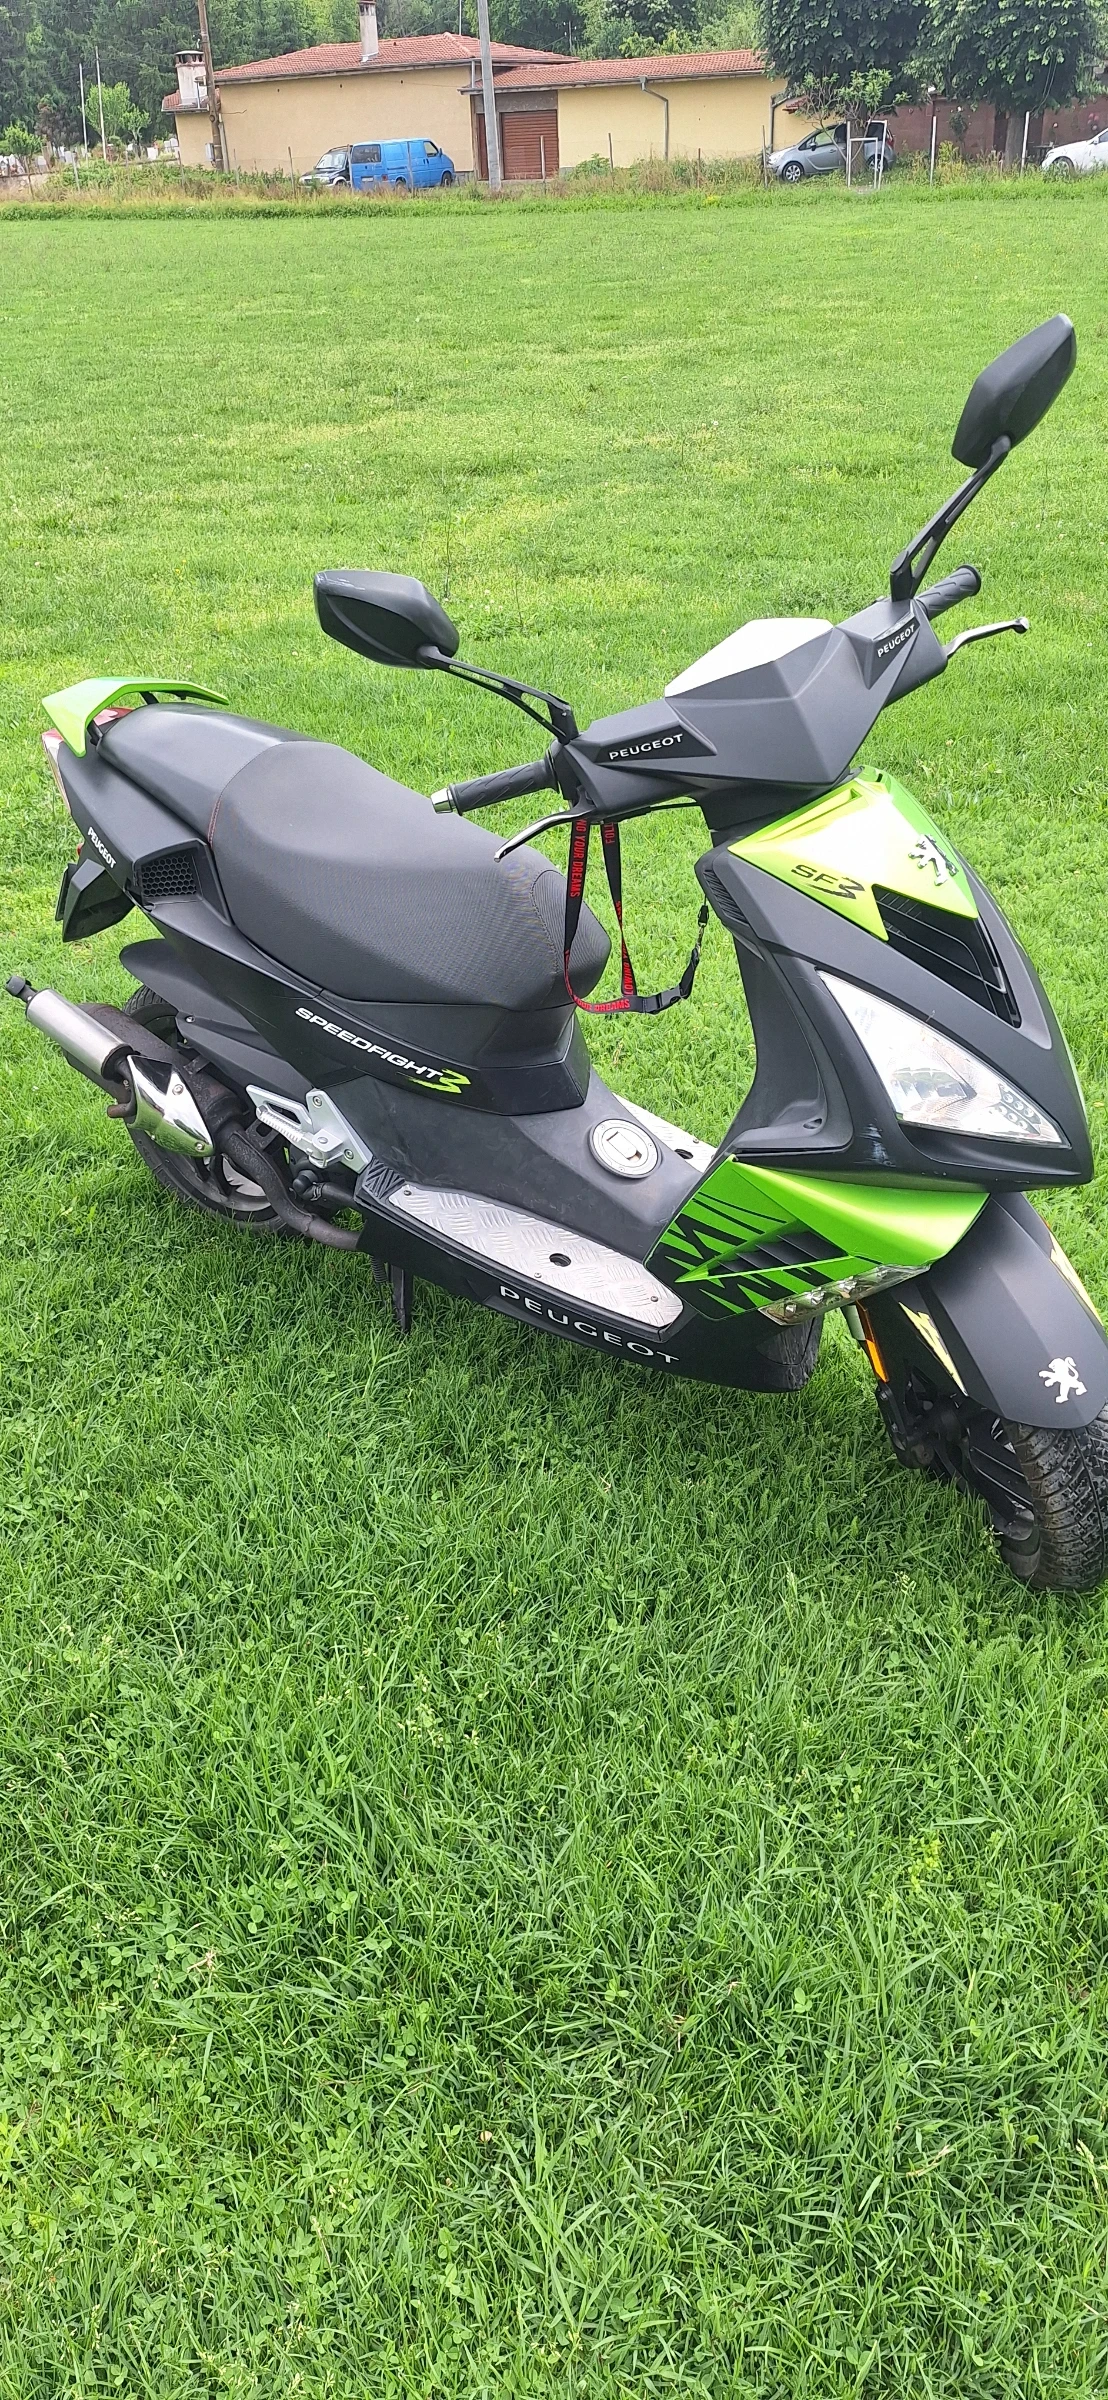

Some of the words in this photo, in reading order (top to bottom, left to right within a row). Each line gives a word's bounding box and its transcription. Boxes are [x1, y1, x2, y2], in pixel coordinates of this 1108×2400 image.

[877, 624, 915, 658] PEUGEOT
[608, 733, 683, 760] PEUGEOT
[87, 826, 117, 869] PEUGEOT
[573, 835, 586, 859] YOUR
[570, 861, 584, 898] DREAMS
[500, 1285, 680, 1364] PEUGEOT
